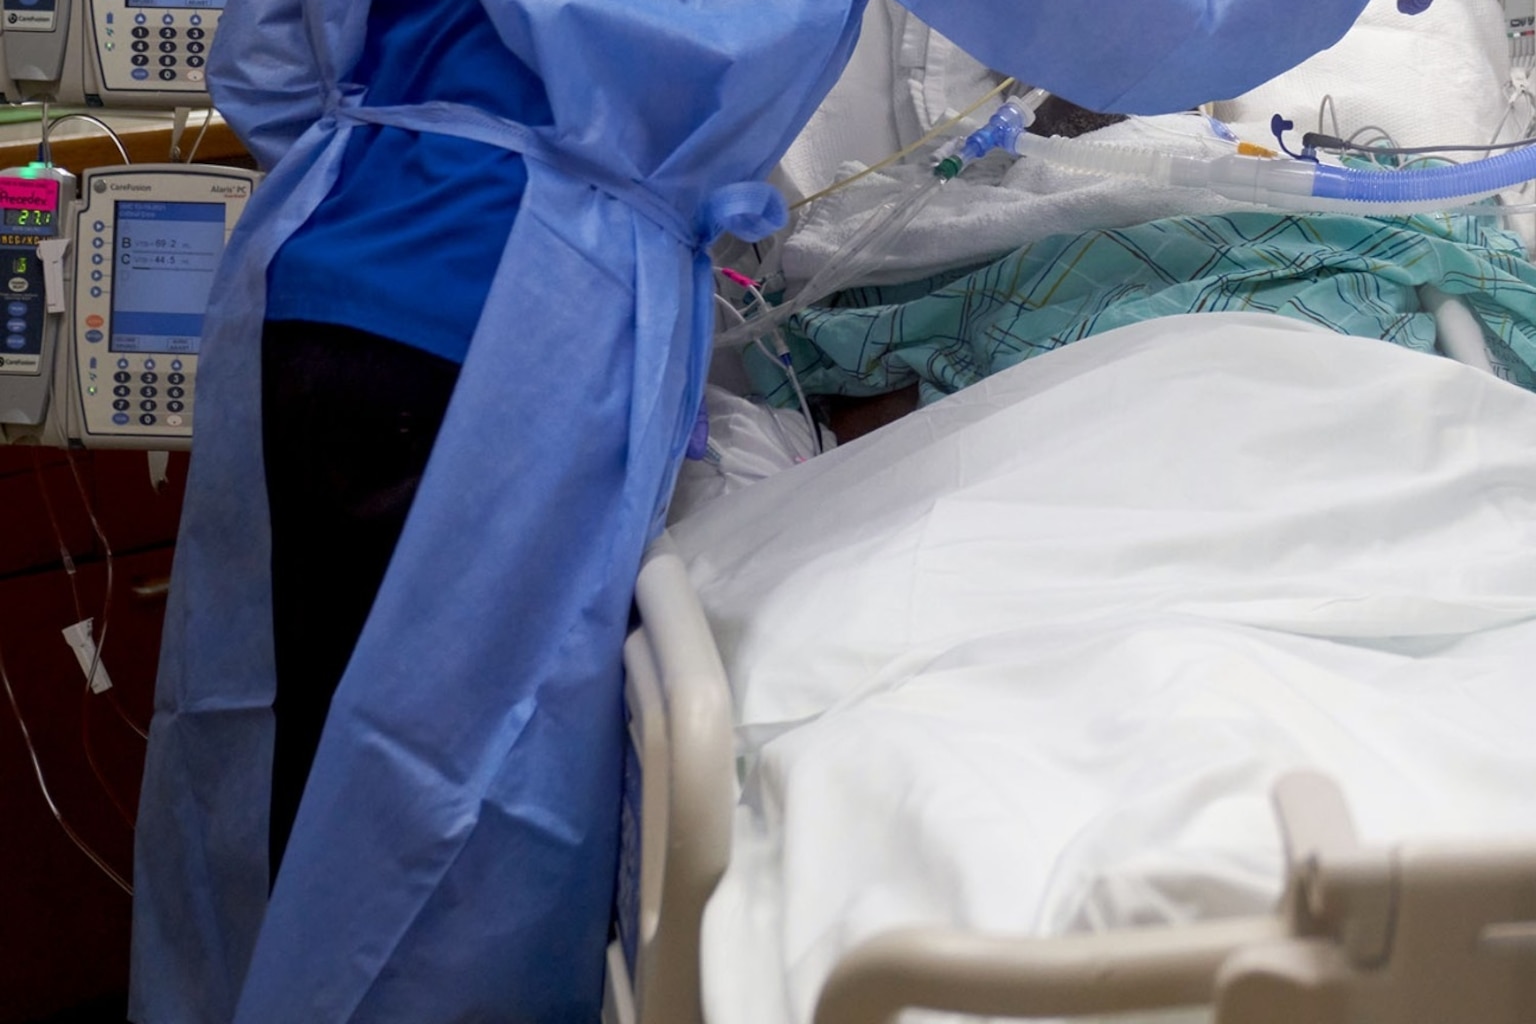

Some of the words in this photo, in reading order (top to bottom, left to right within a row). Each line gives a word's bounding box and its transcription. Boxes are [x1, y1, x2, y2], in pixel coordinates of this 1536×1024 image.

[165, 29, 171, 37] 2
[192, 30, 198, 38] 3
[192, 44, 198, 52] 6
[192, 58, 198, 66] 9
[110, 184, 152, 192] CareFusion
[236, 186, 247, 194] PC
[122, 237, 132, 248] B
[121, 256, 130, 264] C
[146, 374, 152, 382] 2
[146, 388, 152, 396] 5
[146, 402, 151, 410] 8
[172, 402, 178, 410] 9
[144, 416, 151, 424] 0
